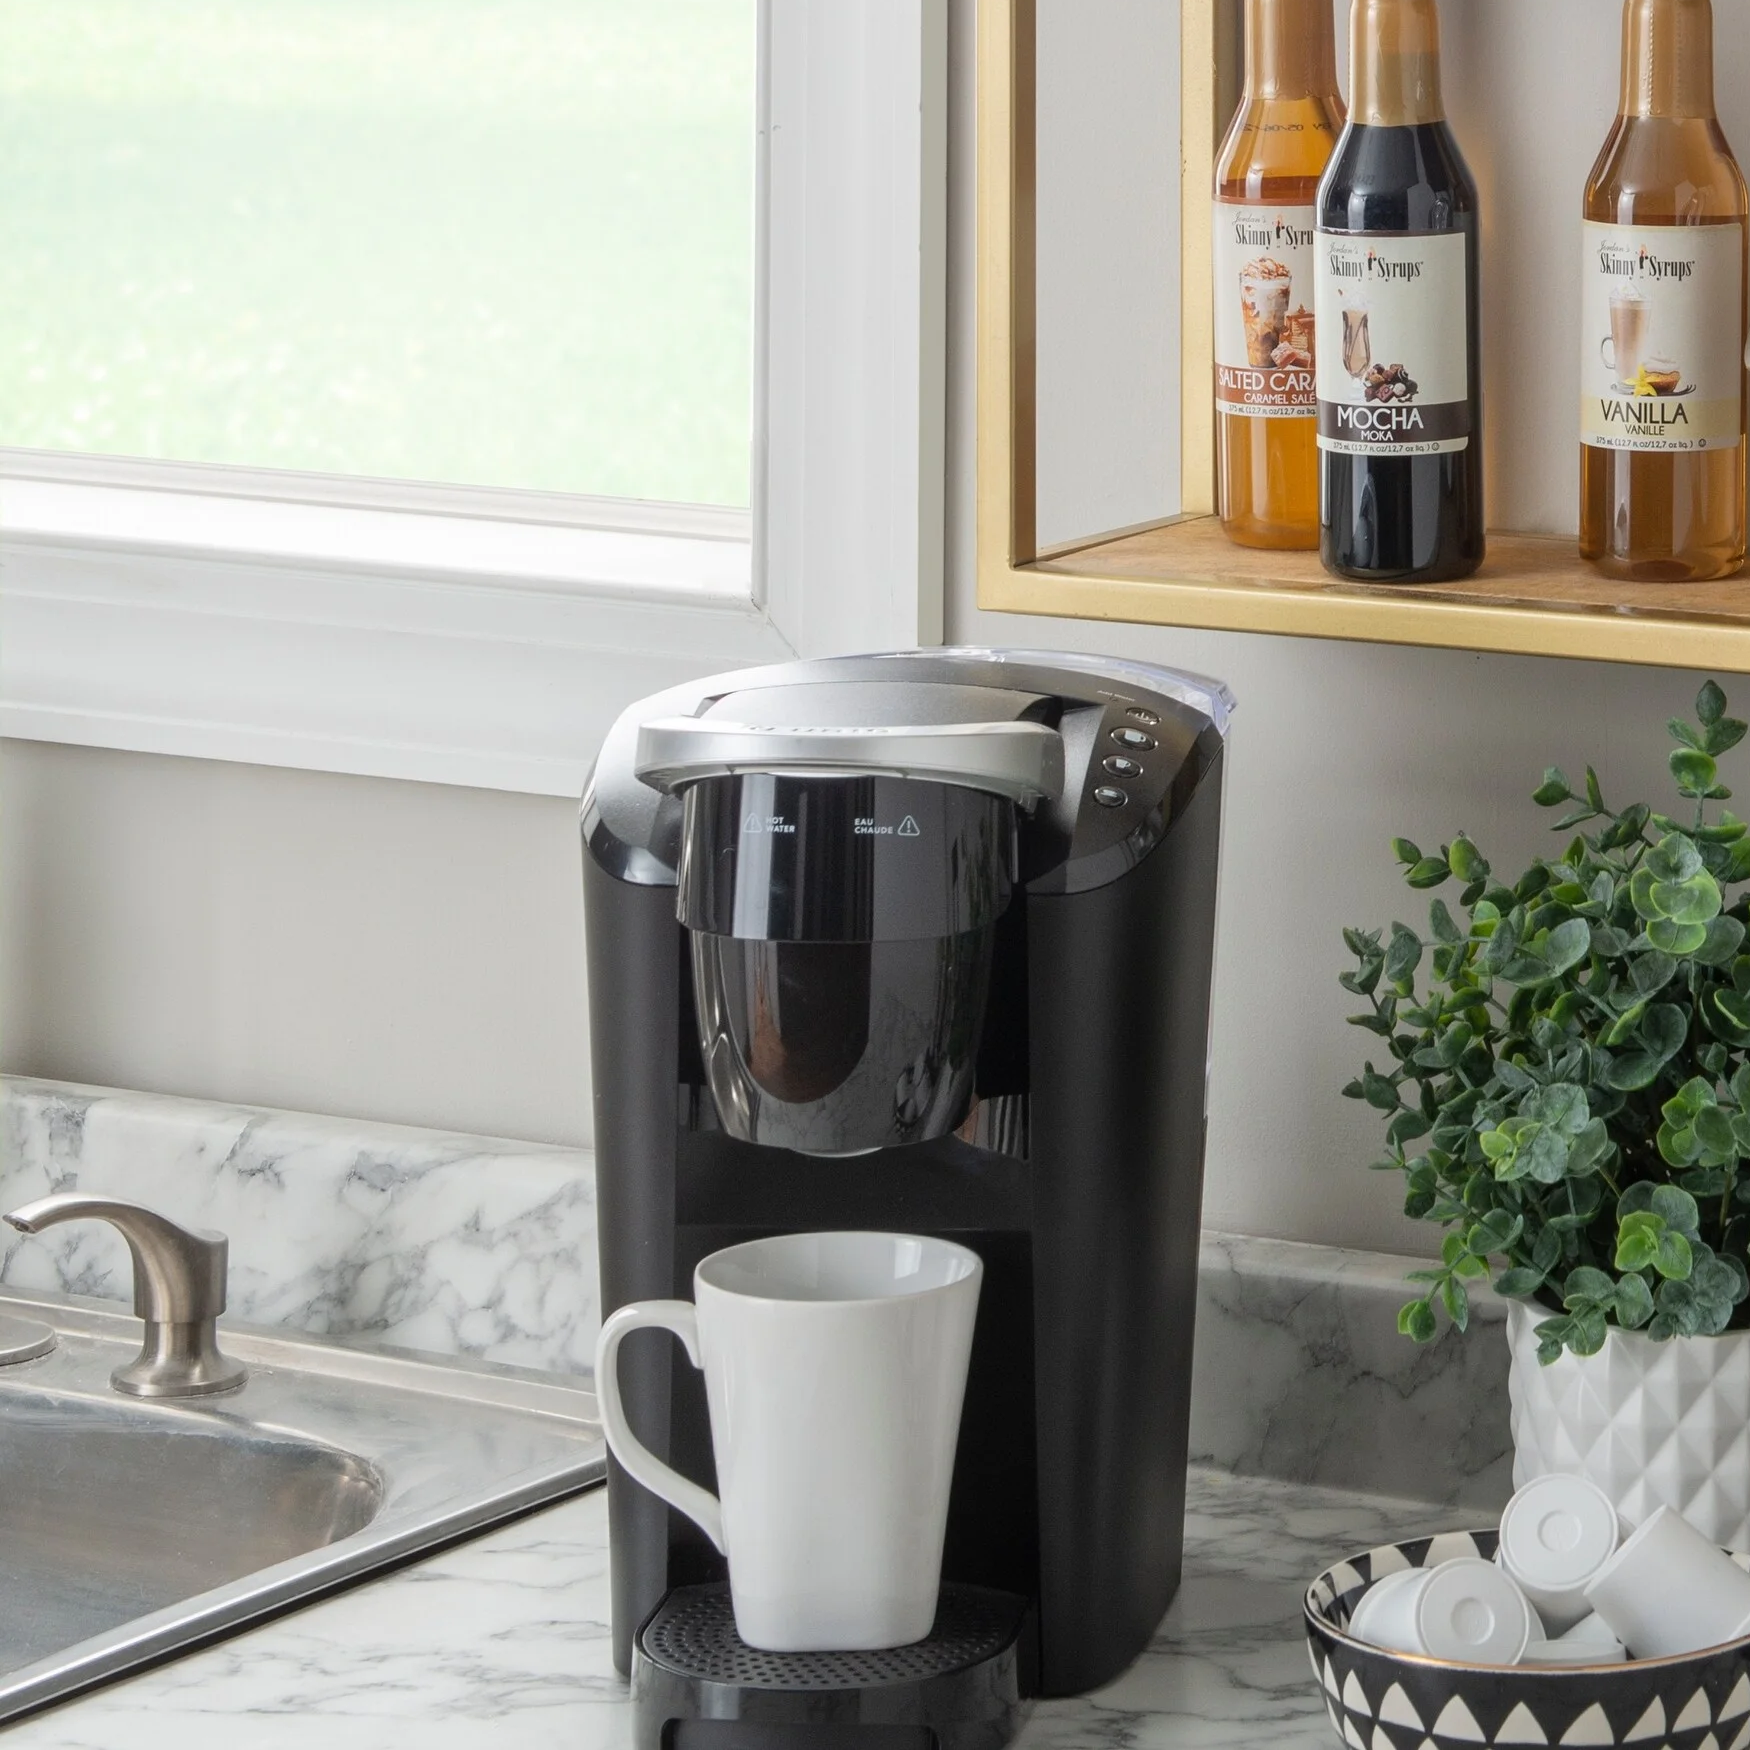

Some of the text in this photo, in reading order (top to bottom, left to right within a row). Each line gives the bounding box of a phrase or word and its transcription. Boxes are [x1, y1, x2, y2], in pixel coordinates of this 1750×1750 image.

[1235, 223, 1272, 250] Skinny
[1330, 254, 1421, 282] Skinny Syrups
[1600, 252, 1692, 282] Skinny Syrups
[1218, 368, 1265, 391] SALTED
[1243, 391, 1316, 405] CARAMEL SALÉ
[1337, 405, 1424, 430] MOCHA
[1600, 399, 1688, 424] VANILLA
[1360, 430, 1394, 441] MOKA
[1625, 424, 1665, 436] VANILLE
[766, 816, 785, 825] HOT
[854, 817, 874, 826] EAU
[766, 825, 796, 834] WATER
[854, 826, 894, 835] CHAUDE
